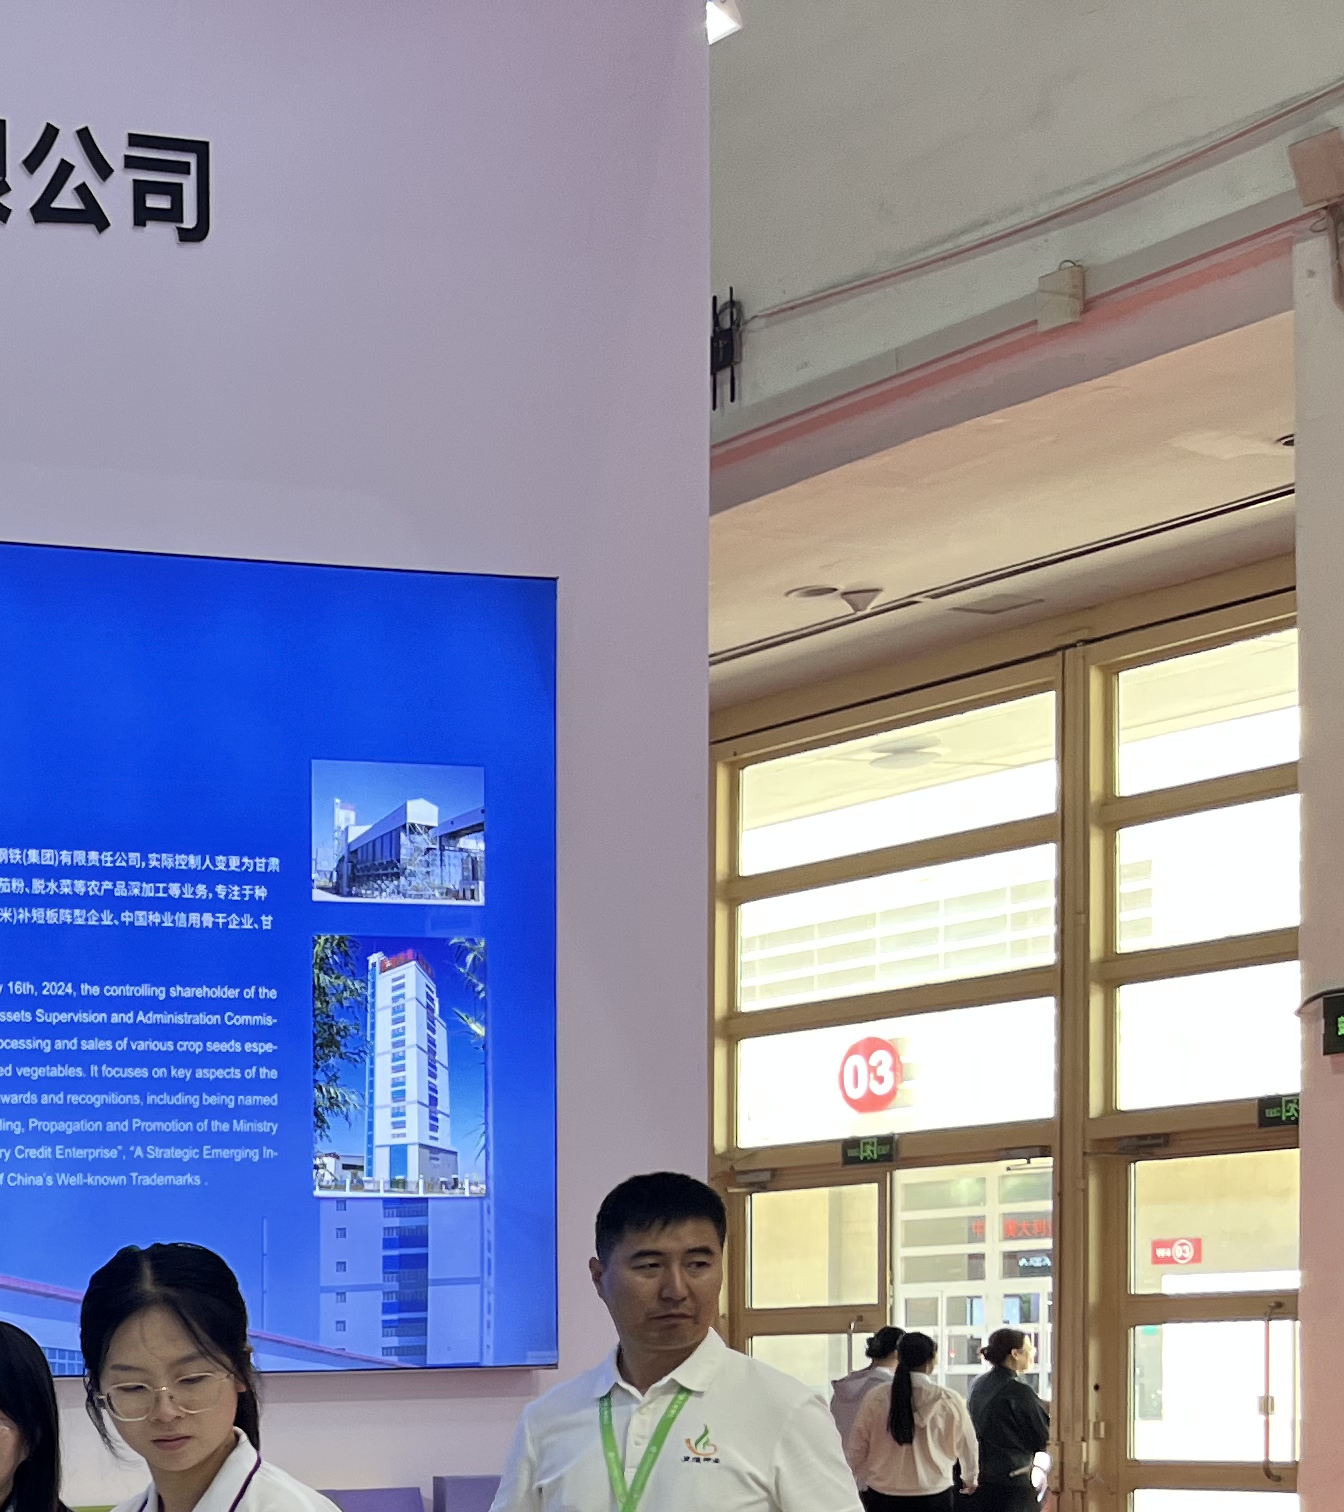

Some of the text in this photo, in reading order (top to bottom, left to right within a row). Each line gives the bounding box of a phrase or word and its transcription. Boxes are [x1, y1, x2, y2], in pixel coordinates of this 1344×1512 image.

[79, 982, 101, 996] the
[103, 983, 167, 1001] controlling
[168, 984, 241, 999] shareholder
[242, 985, 257, 999] of
[257, 985, 278, 999] the
[35, 1009, 108, 1026] Supervision
[110, 1010, 135, 1024] and
[135, 1010, 222, 1025] Administration
[53, 1037, 79, 1051] and
[80, 1037, 114, 1050] sales
[114, 1036, 129, 1051] of
[129, 1038, 175, 1051] various
[176, 1040, 204, 1055] crop
[205, 1039, 243, 1053] seeds
[843, 1050, 896, 1100] 03
[1175, 1244, 1191, 1259] 03
